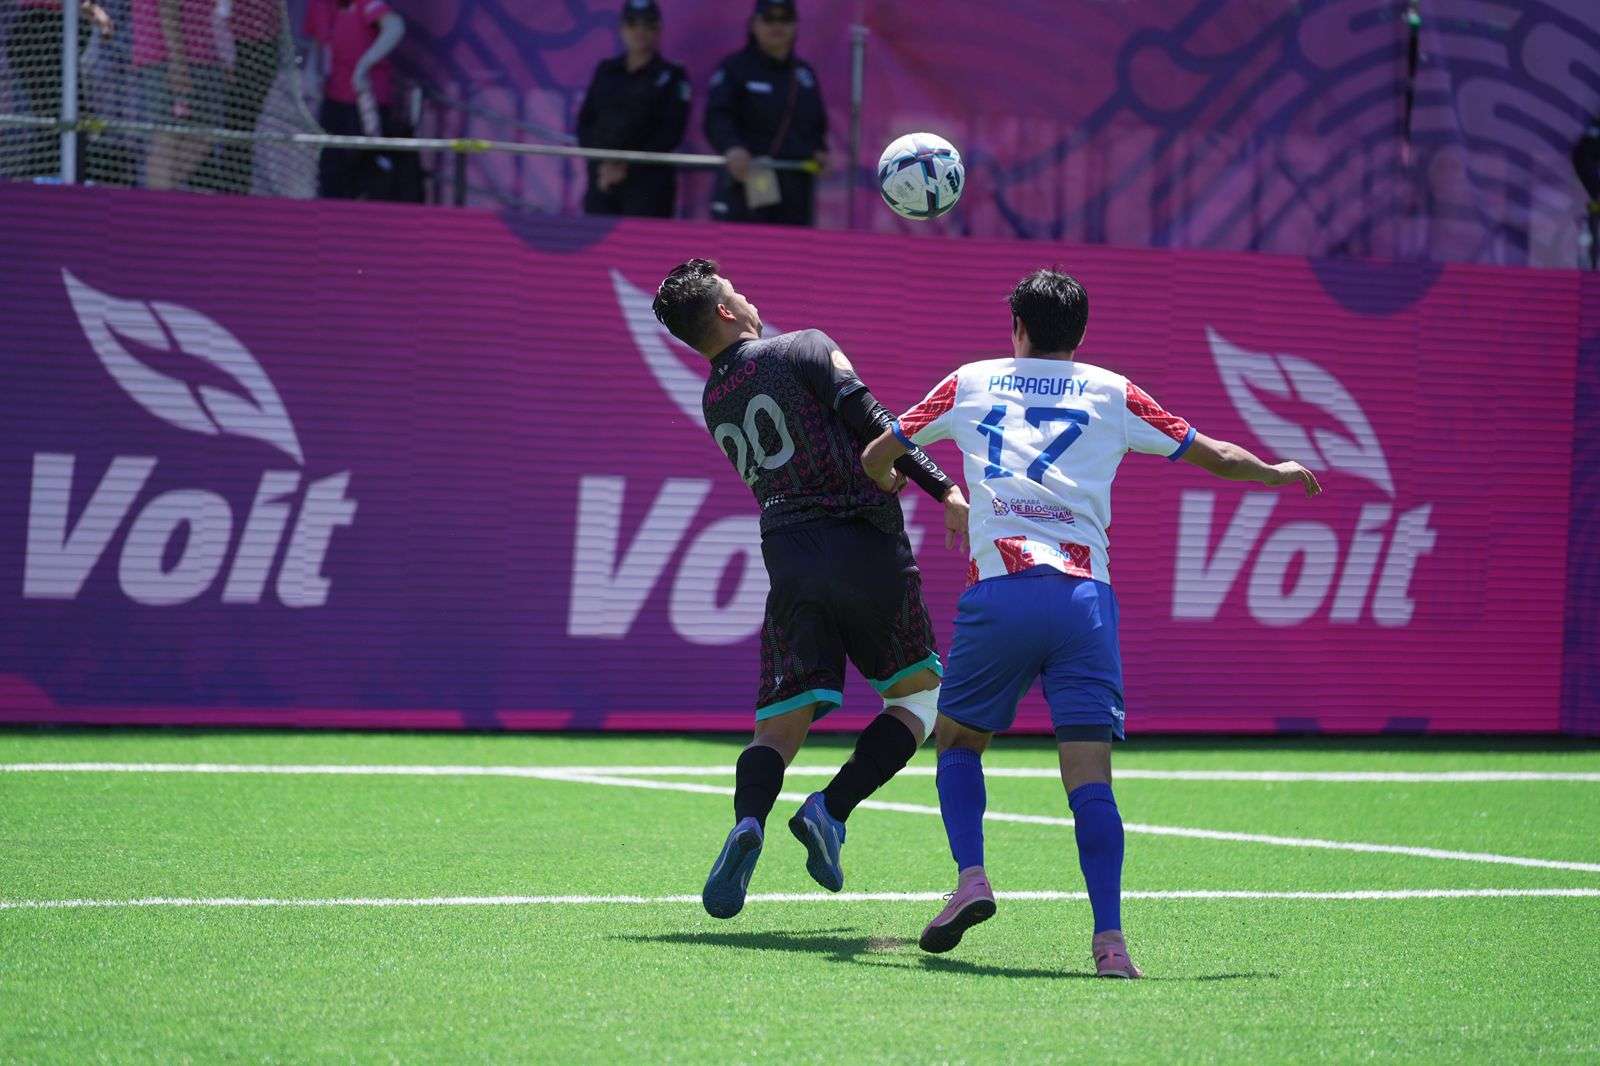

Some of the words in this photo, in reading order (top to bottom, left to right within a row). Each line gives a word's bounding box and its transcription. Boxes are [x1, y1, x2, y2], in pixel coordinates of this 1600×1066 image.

[707, 360, 757, 405] MEXICO
[988, 375, 1088, 396] PARAGUAY
[714, 393, 795, 486] 20
[976, 405, 1090, 485] 17
[23, 452, 358, 608] Voit
[1010, 504, 1022, 512] DE
[1171, 489, 1439, 626] Voit
